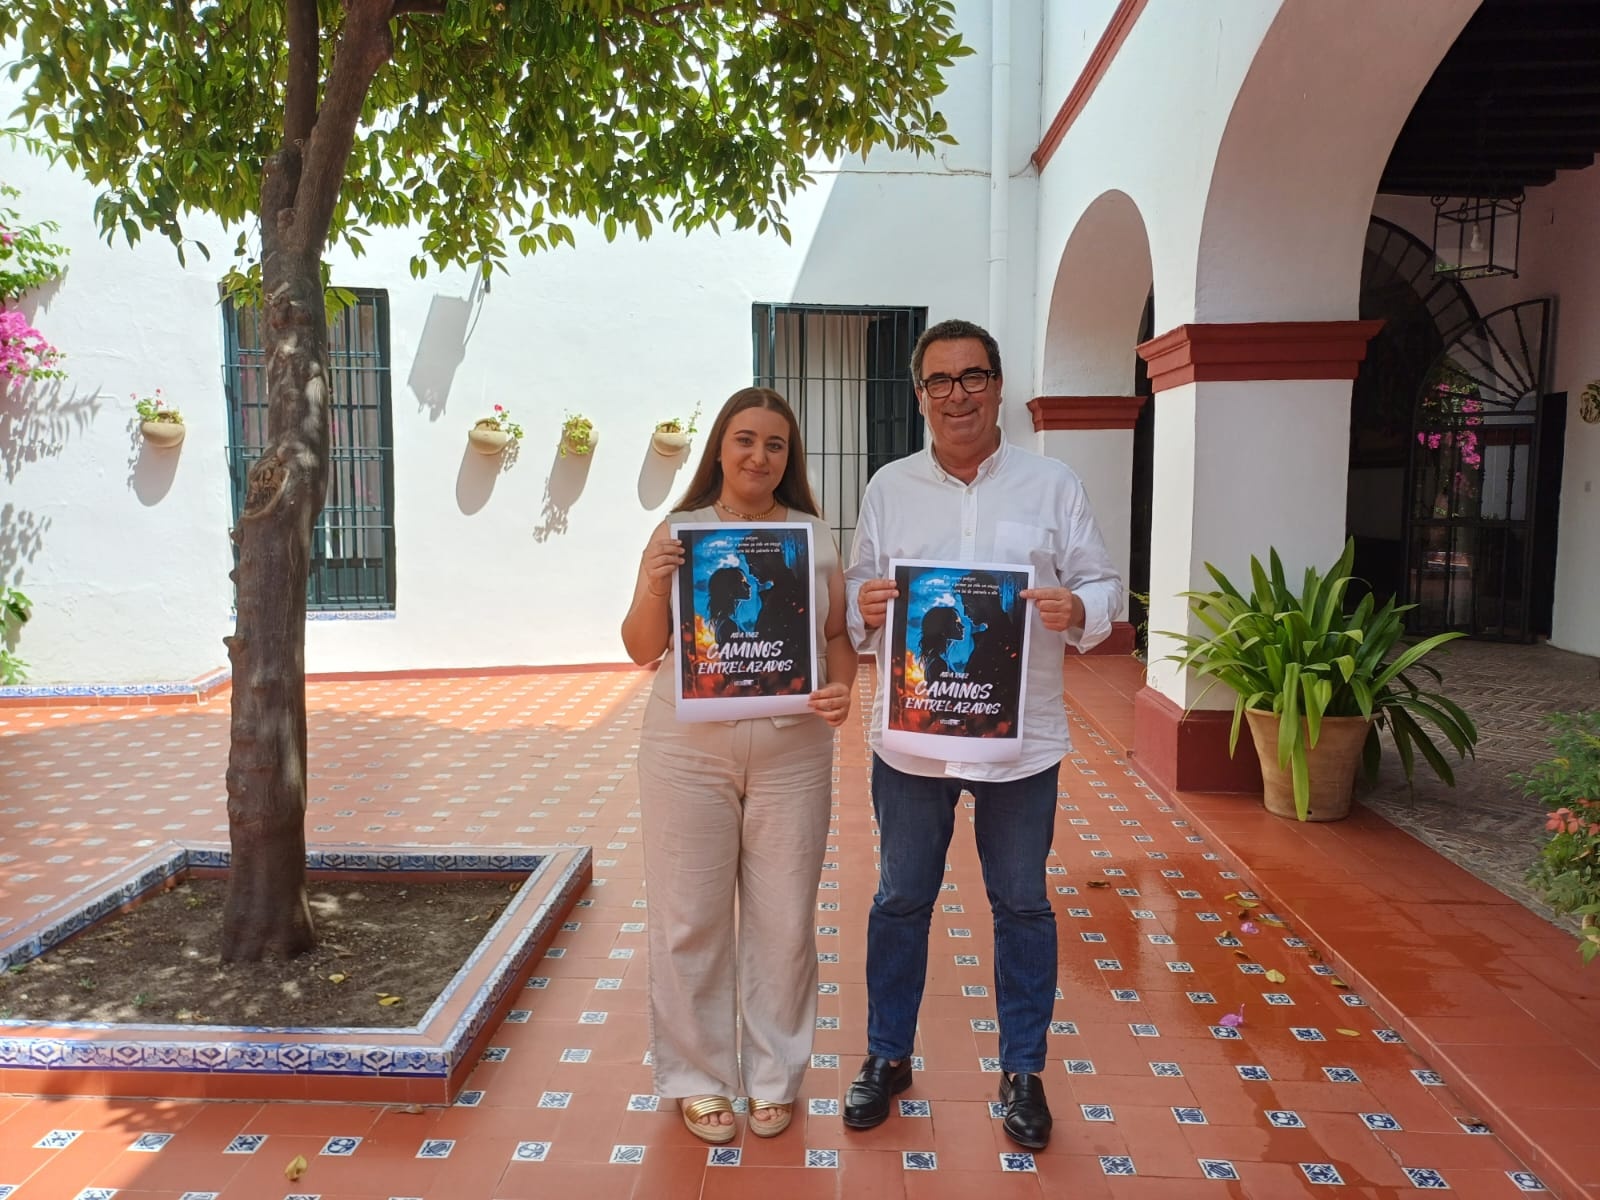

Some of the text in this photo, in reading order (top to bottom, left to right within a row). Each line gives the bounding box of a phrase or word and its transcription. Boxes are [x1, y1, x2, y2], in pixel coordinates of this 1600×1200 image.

[707, 640, 784, 660] CAMINOS
[698, 659, 794, 676] ENTRELAZADOS
[914, 680, 993, 700] CAMINOS
[905, 697, 1001, 715] ENTRELAZADOS
